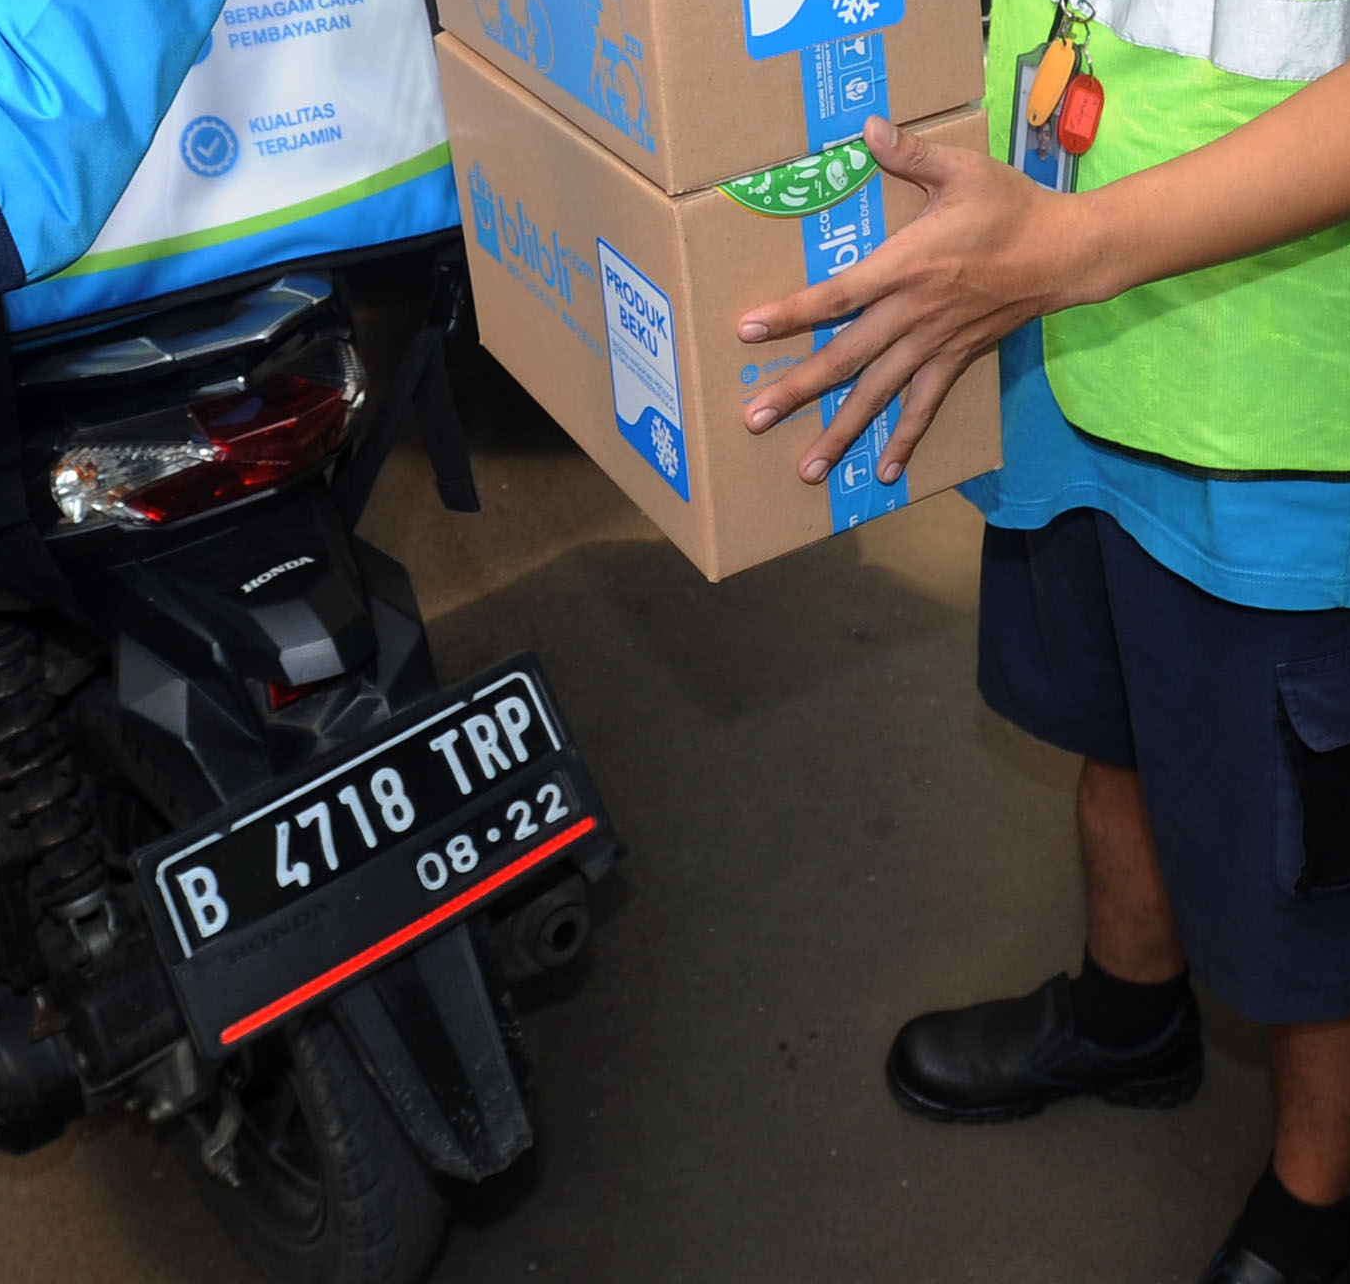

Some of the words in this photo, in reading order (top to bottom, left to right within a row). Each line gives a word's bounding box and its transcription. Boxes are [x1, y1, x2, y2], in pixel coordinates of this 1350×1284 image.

[228, 14, 352, 49] PEMBAYARAN
[249, 103, 337, 134] KUALITAS
[254, 126, 343, 157] TERJAMIN
[859, 185, 869, 217] DEAL
[605, 265, 668, 340] PRODUK
[619, 305, 658, 357] BEKU
[240, 555, 316, 594] HONDA
[176, 864, 230, 939] B
[274, 766, 416, 888] 4718
[428, 695, 534, 796] TRP
